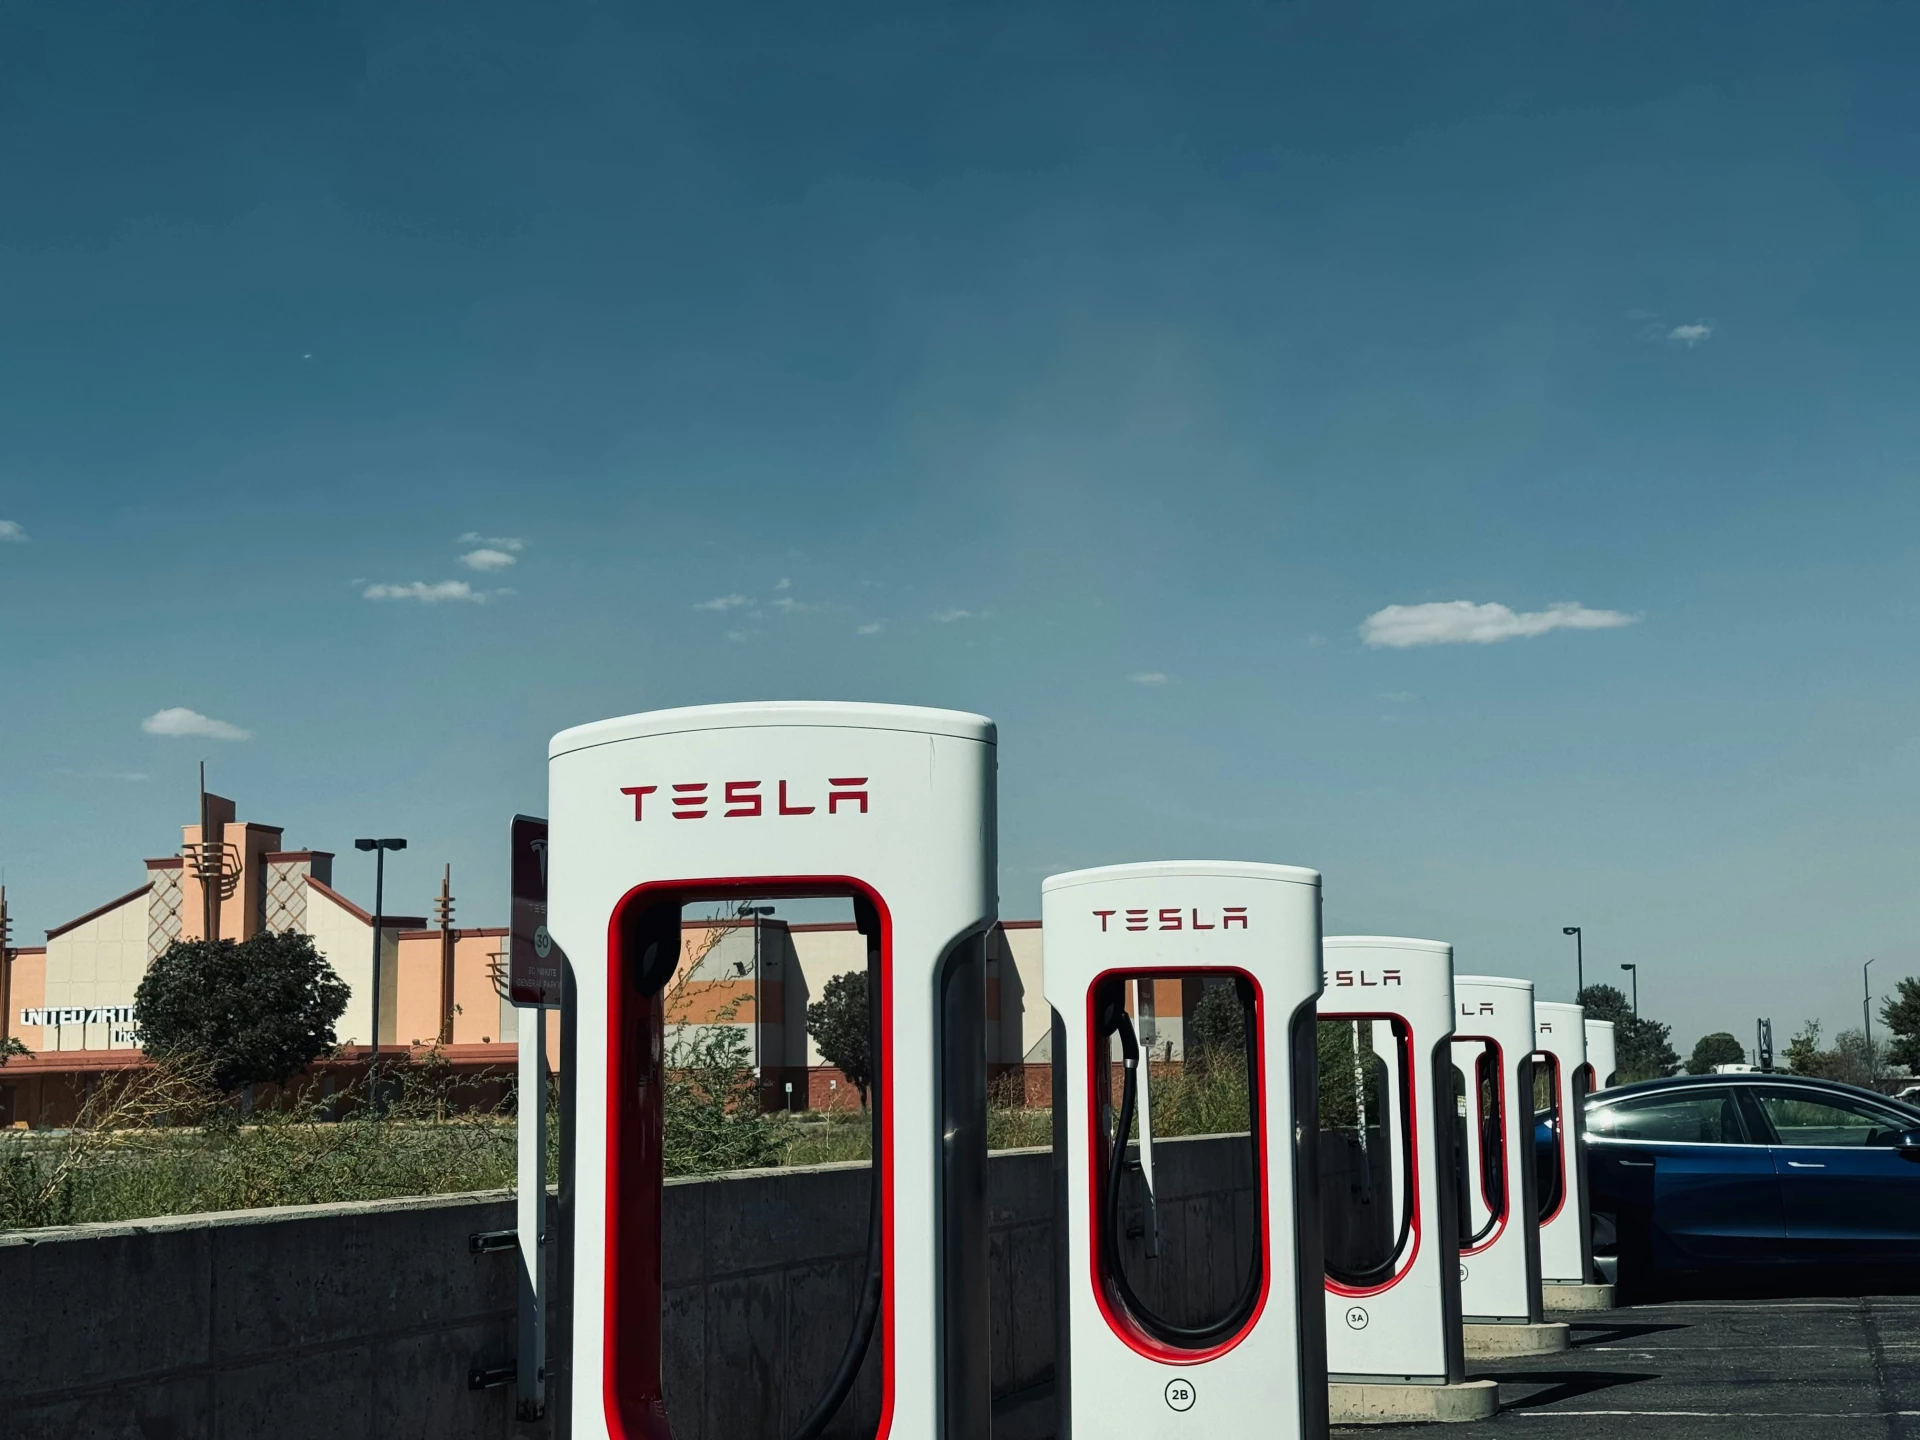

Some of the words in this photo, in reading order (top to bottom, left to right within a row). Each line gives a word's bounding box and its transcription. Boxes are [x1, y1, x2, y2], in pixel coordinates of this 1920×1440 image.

[620, 777, 868, 821] TESLA
[1092, 907, 1248, 932] TESLA
[537, 934, 549, 948] 30
[20, 1006, 86, 1025] UNITED
[1351, 1314, 1364, 1322] 3A
[1172, 1389, 1189, 1400] 2B
